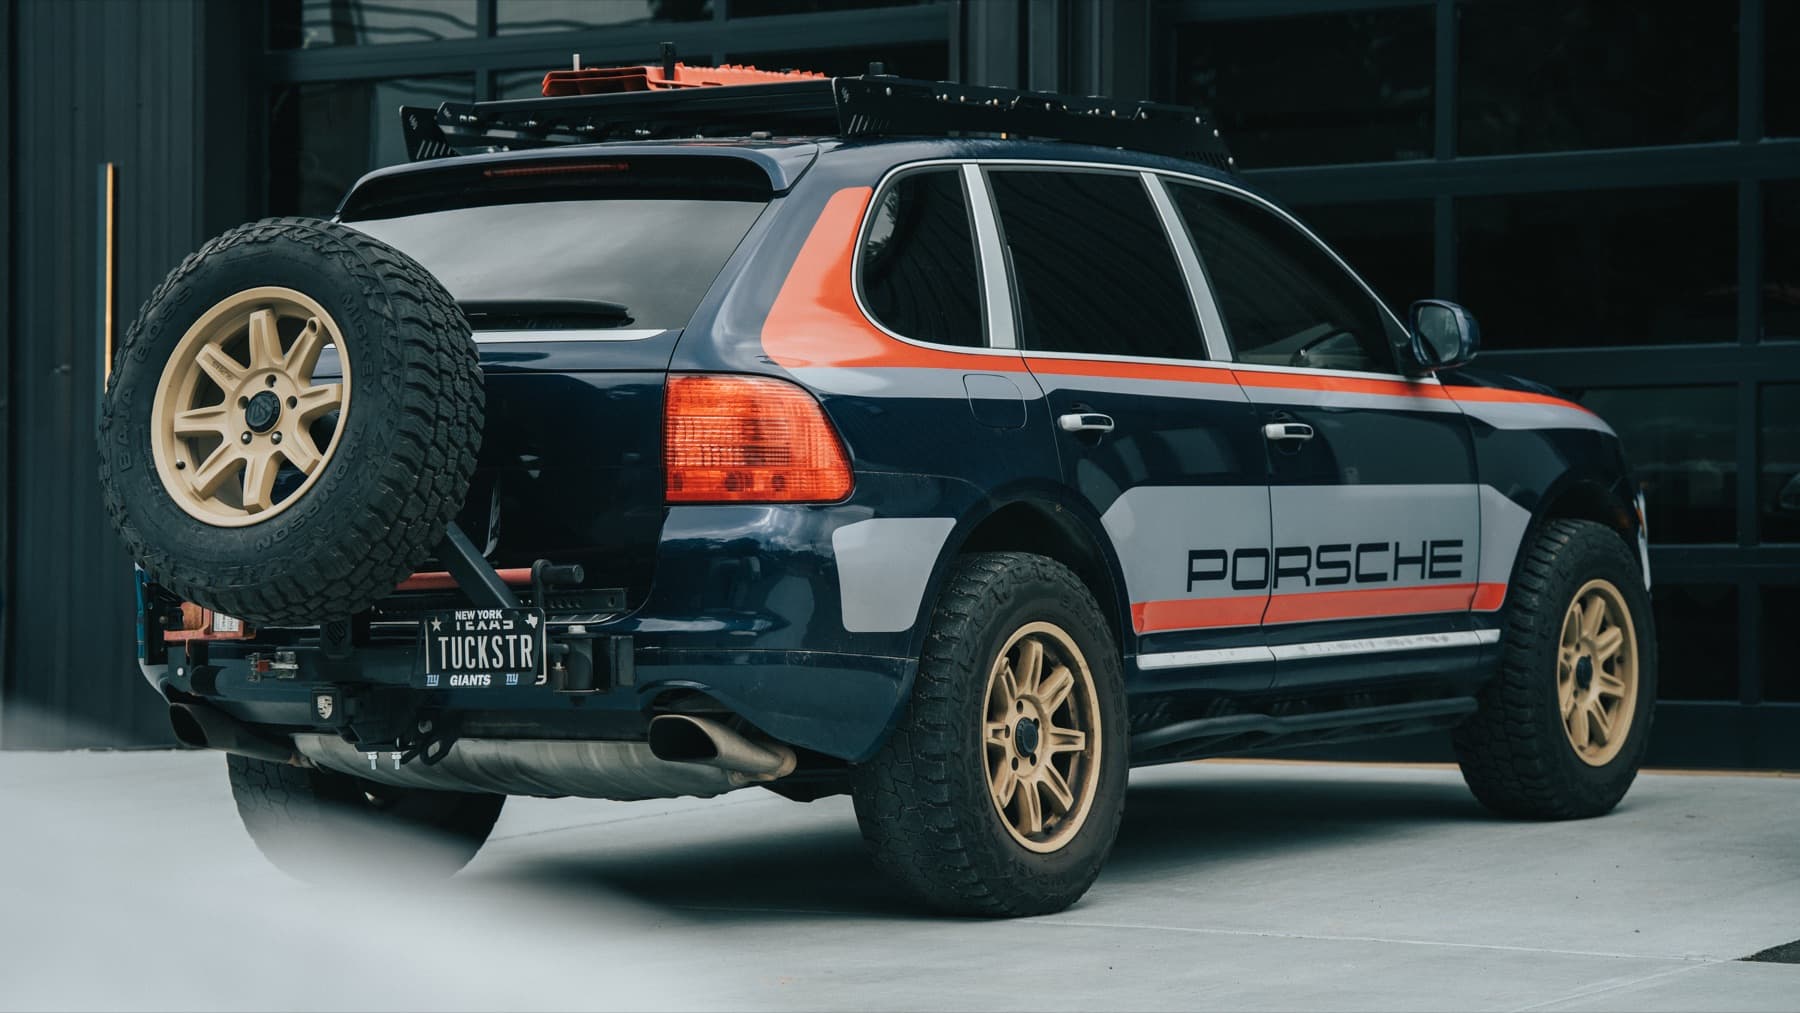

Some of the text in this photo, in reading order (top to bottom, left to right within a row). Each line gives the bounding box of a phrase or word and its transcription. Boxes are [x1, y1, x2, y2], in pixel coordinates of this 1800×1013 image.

[1187, 539, 1463, 592] PORSCHE
[455, 609, 503, 620] NEW YORK
[456, 620, 514, 631] TEXAS
[438, 634, 533, 670] TUCKSTR
[449, 674, 492, 686] GIANTS
